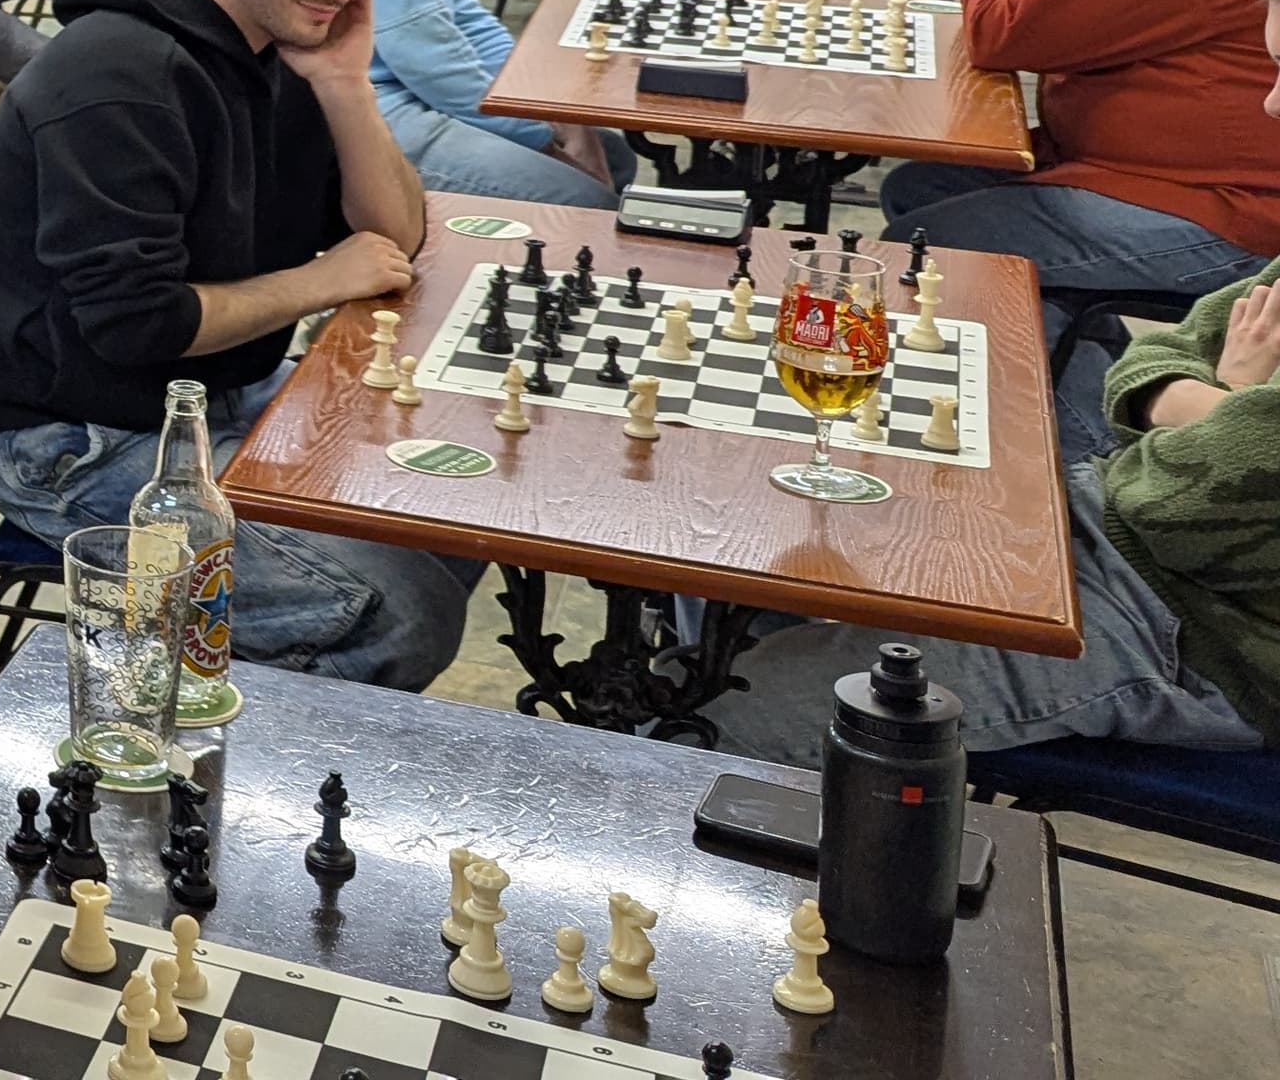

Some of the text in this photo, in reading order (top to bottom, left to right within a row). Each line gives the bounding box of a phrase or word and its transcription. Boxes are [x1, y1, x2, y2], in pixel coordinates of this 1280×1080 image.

[18, 937, 32, 945] a
[286, 970, 305, 980] 3
[384, 995, 404, 1005] 4
[488, 1021, 508, 1031] 5
[592, 1046, 613, 1056] 6
